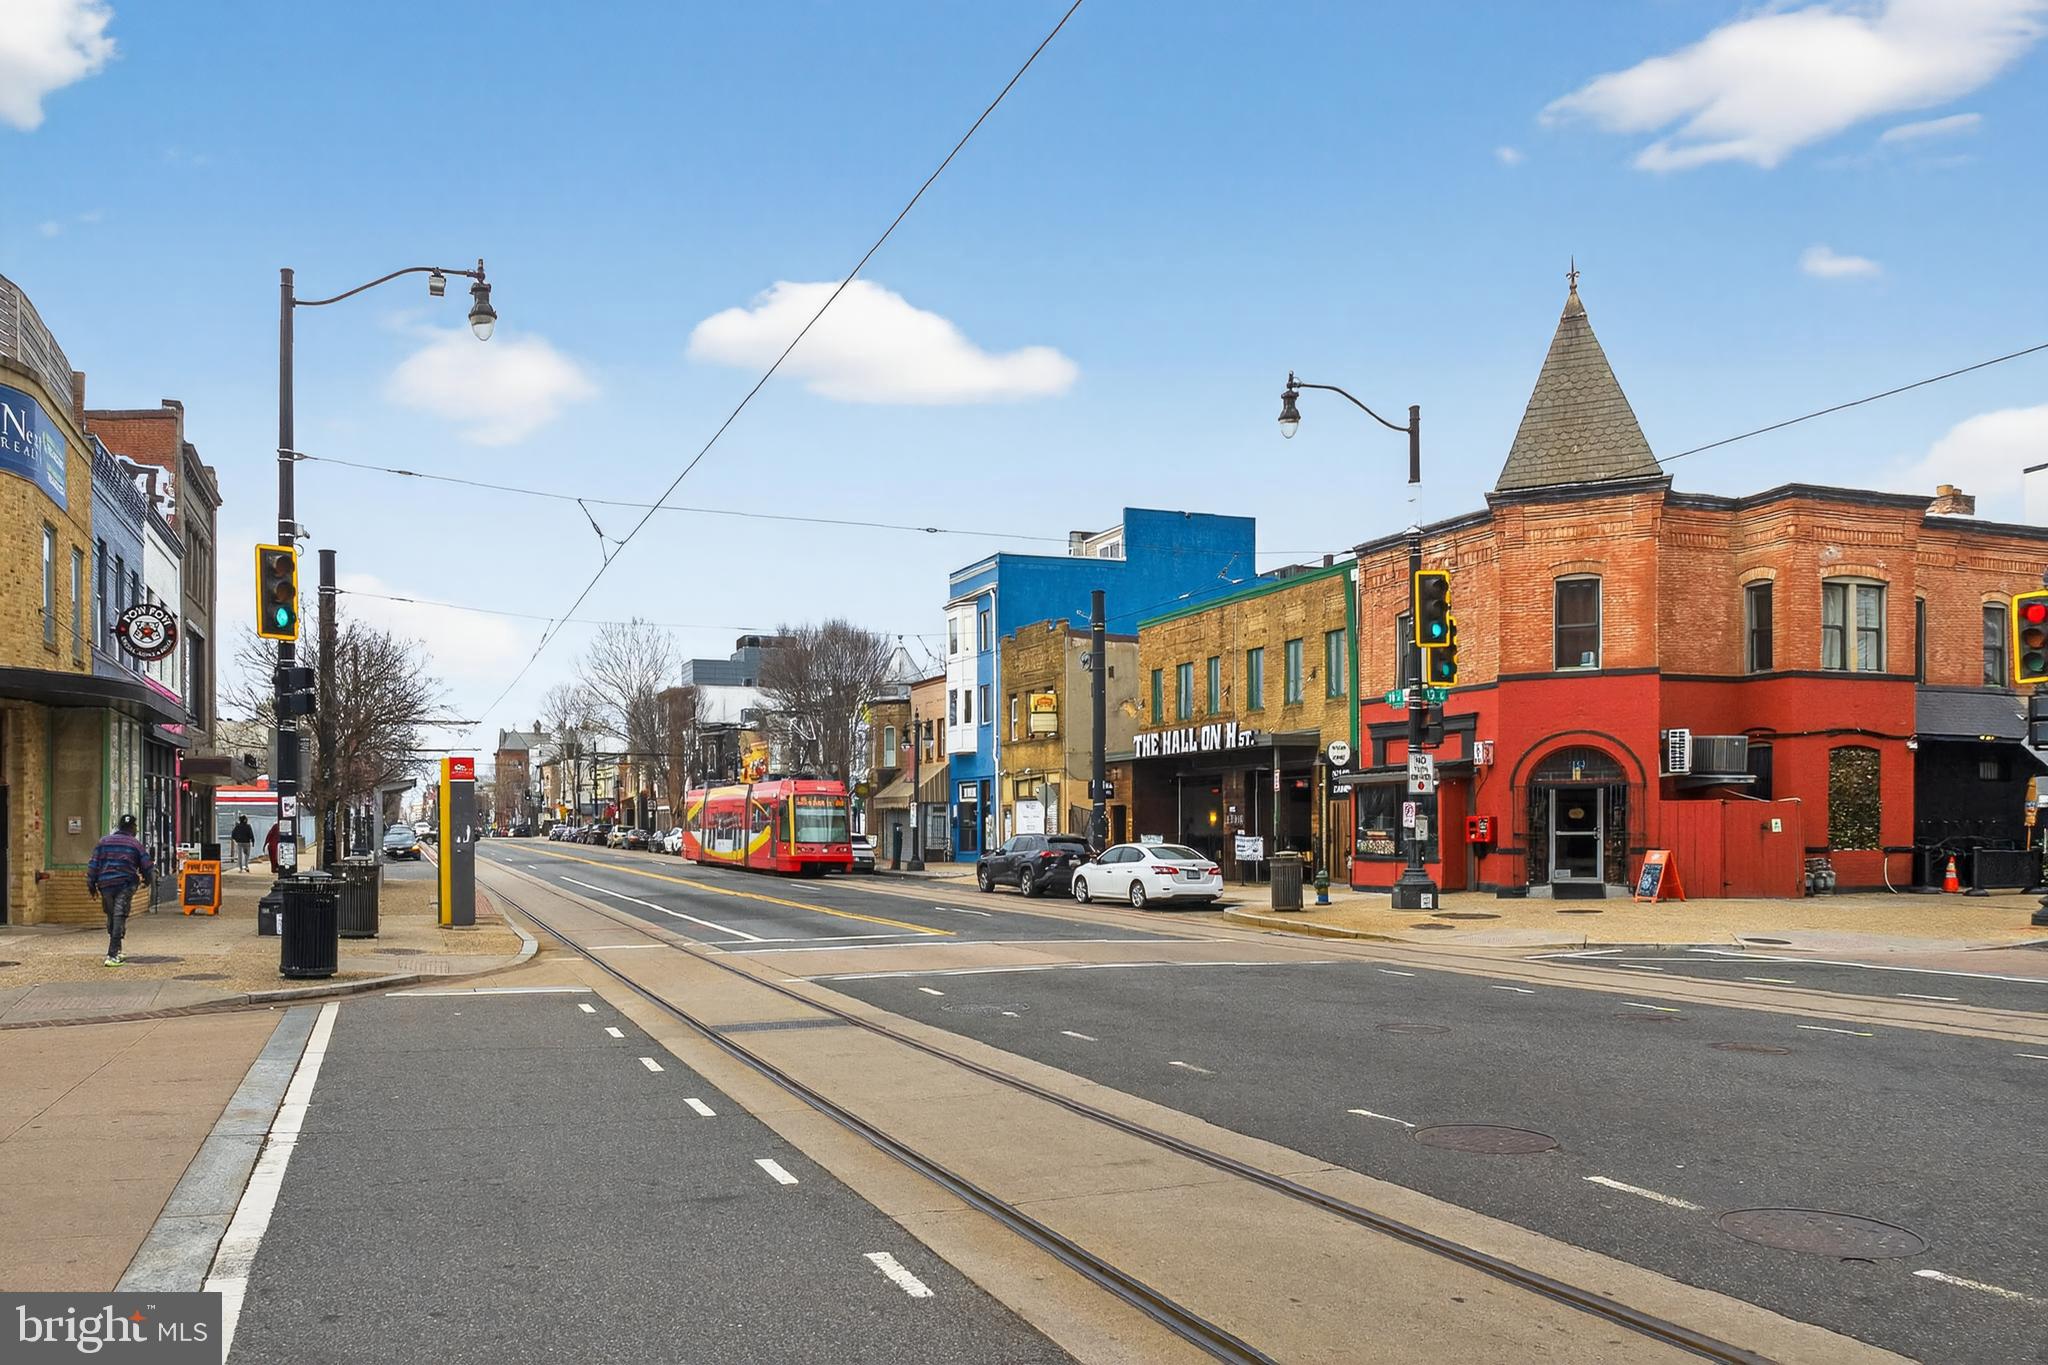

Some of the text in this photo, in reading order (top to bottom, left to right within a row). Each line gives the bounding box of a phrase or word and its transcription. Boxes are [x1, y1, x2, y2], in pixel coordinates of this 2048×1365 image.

[1133, 721, 1255, 757] THE HALL ON H ST.
[1415, 756, 1427, 765] NO
